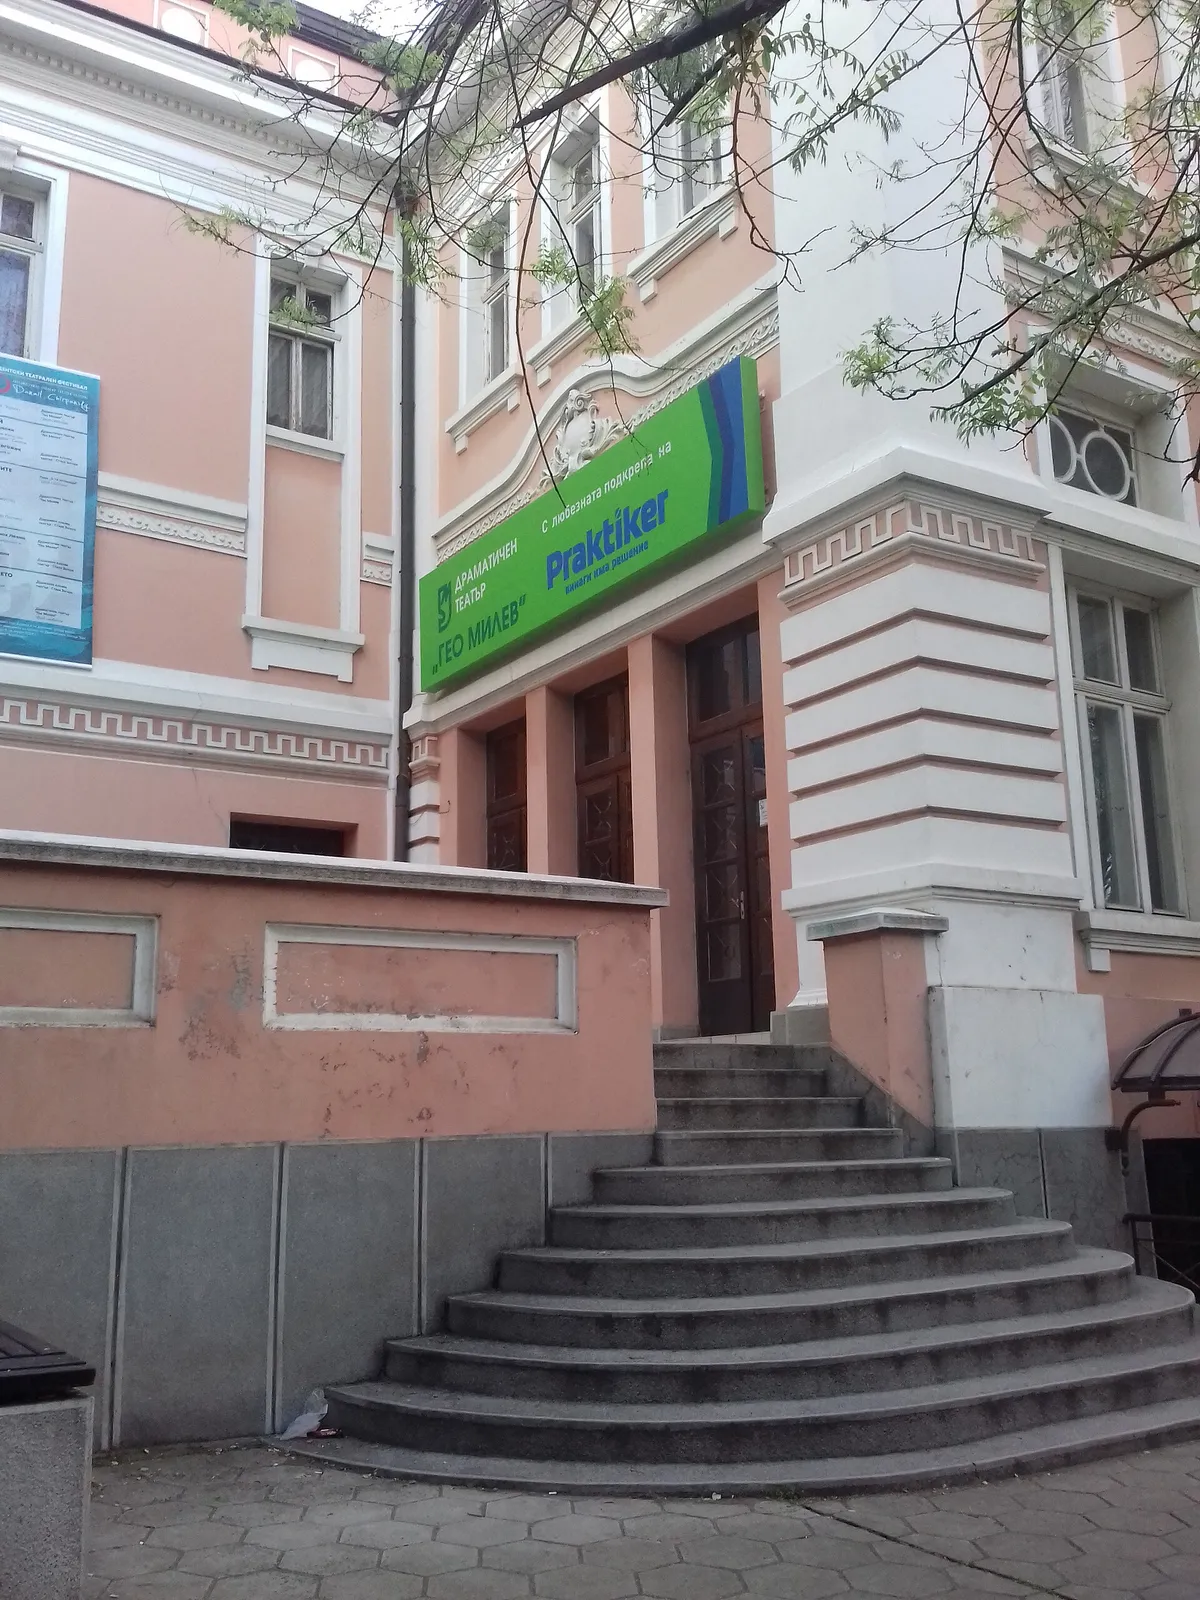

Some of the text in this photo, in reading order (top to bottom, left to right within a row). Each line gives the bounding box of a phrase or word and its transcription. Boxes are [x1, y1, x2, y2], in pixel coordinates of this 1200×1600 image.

[25, 372, 56, 384] ТЕАТРАЛЕН
[57, 379, 88, 391] ФЕСТИВАЛ
[551, 487, 602, 529] любезната
[604, 452, 653, 494] подкрепа
[658, 440, 672, 459] на
[546, 489, 669, 591] Praktiker
[593, 564, 609, 578] има
[611, 540, 649, 571] решение
[454, 538, 518, 595] ДРАМАТИЧЕН
[455, 582, 487, 614] ТЕАТЪР
